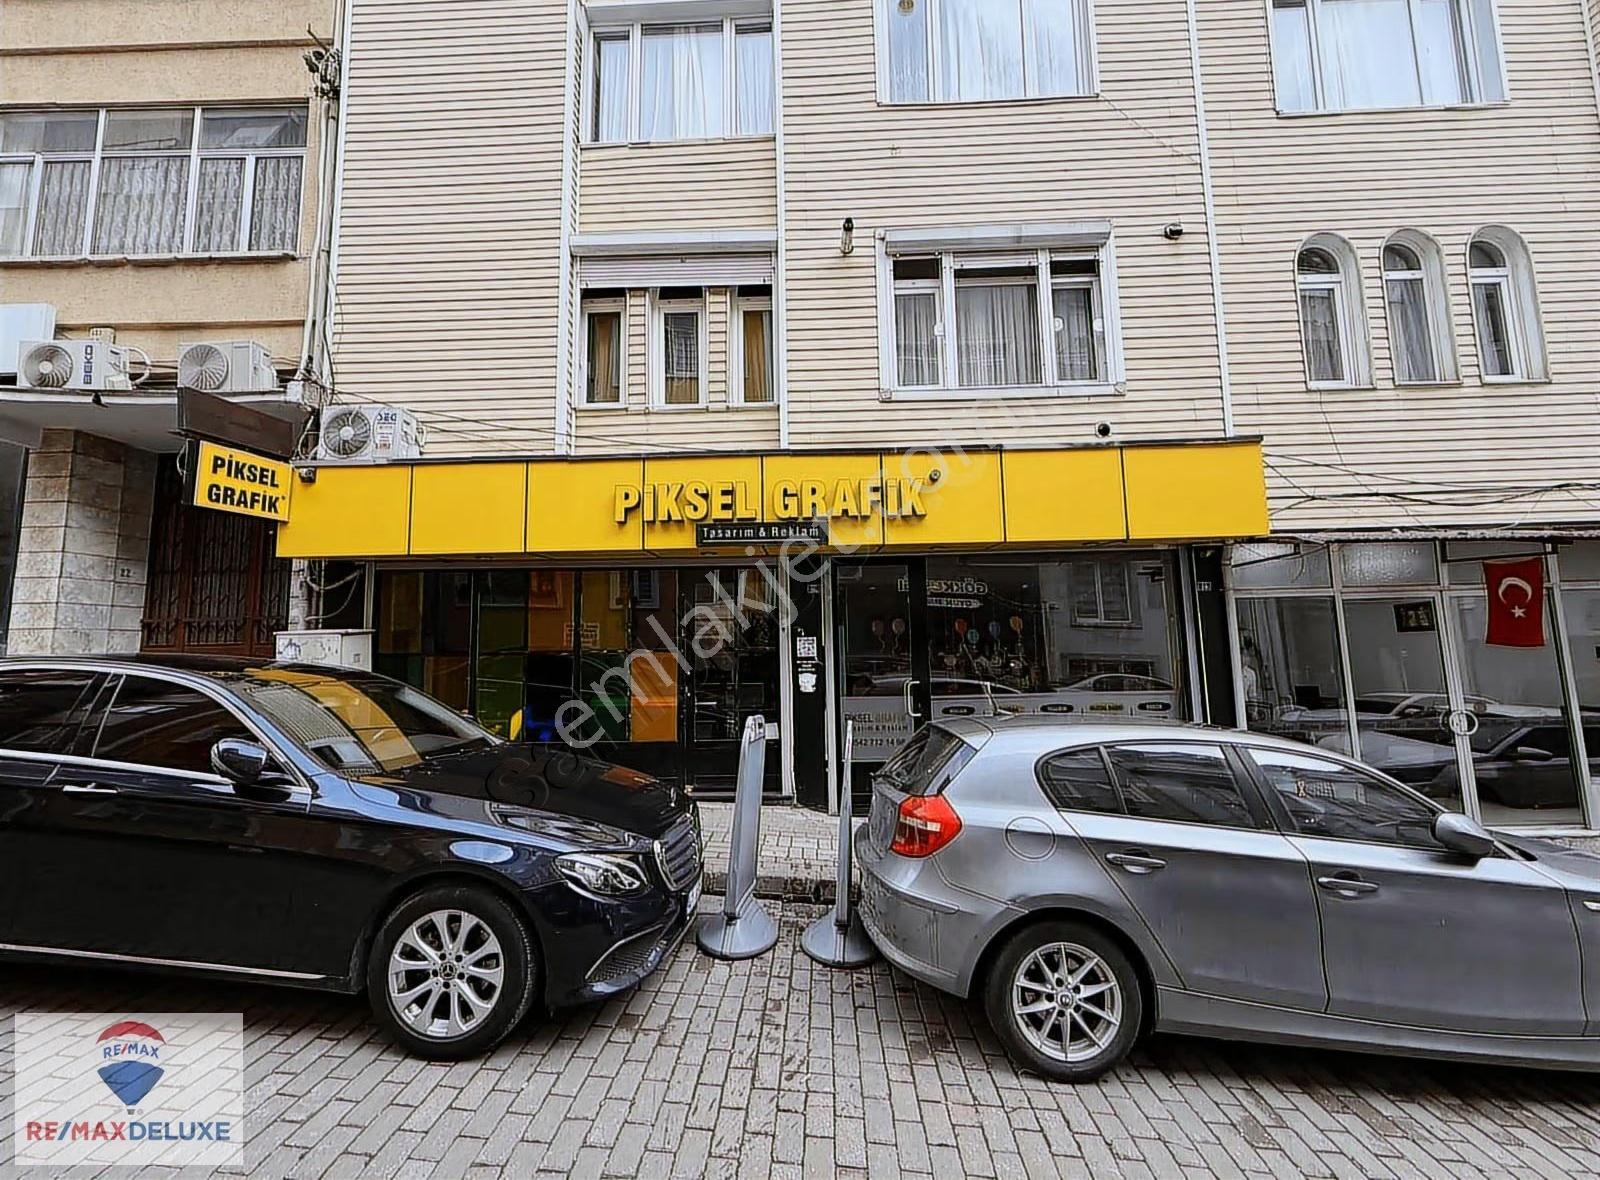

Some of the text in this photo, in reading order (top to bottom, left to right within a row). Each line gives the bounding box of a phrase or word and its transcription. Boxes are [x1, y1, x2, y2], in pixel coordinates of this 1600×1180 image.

[83, 344, 93, 385] BEKO
[211, 454, 280, 489] PİKSEL
[207, 483, 280, 514] GRAFİK
[613, 477, 928, 524] PİKSEL GRAFİK
[758, 526, 767, 538] &
[771, 525, 819, 538] Reklam
